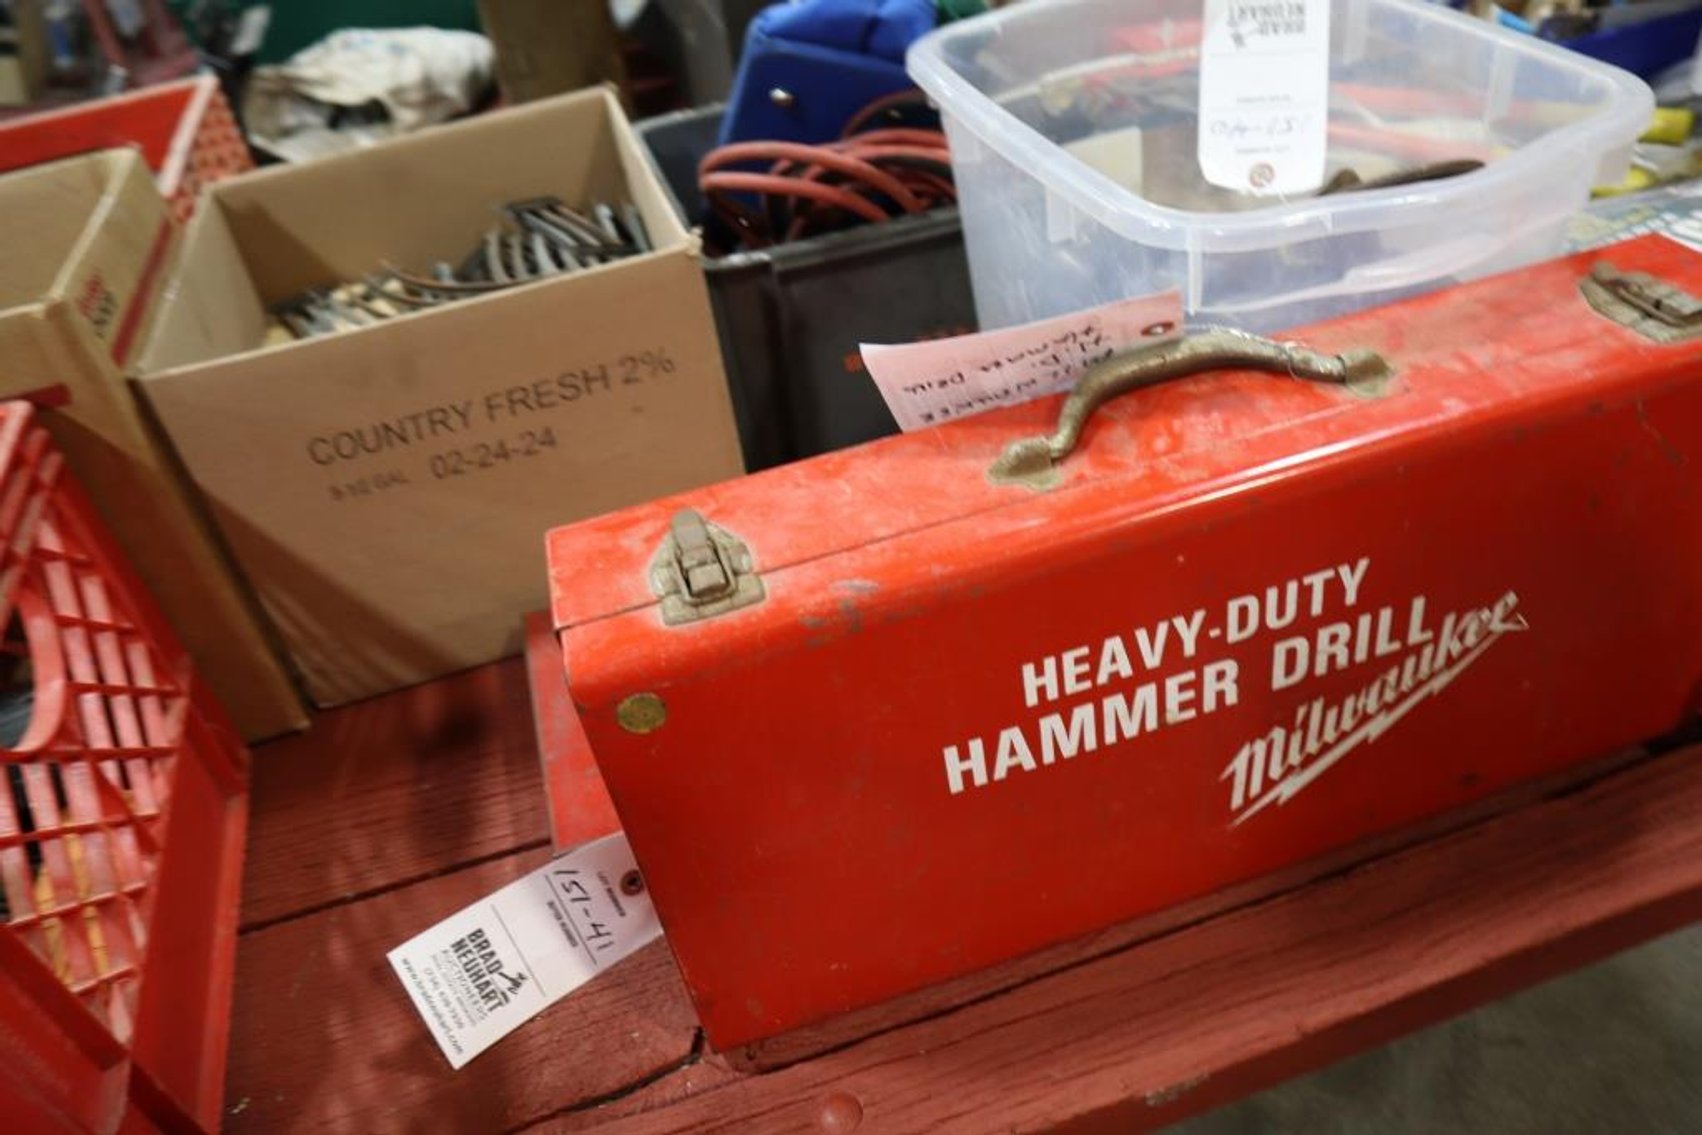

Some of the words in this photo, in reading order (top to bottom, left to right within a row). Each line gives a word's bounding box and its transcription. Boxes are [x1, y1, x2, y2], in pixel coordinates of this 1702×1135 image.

[306, 400, 474, 466] COUNTRY
[484, 364, 611, 422] FRESH
[618, 348, 676, 385] 2%
[430, 426, 558, 480] 02-24-24
[1021, 557, 1370, 707] HEAVY-DUTY
[942, 659, 1239, 795] HAMMER
[1270, 595, 1434, 692] DRILL
[1220, 590, 1529, 812] Milwaukee
[467, 927, 503, 975] BRAD
[553, 870, 615, 951] 151-41
[451, 938, 505, 1012] NEUHART
